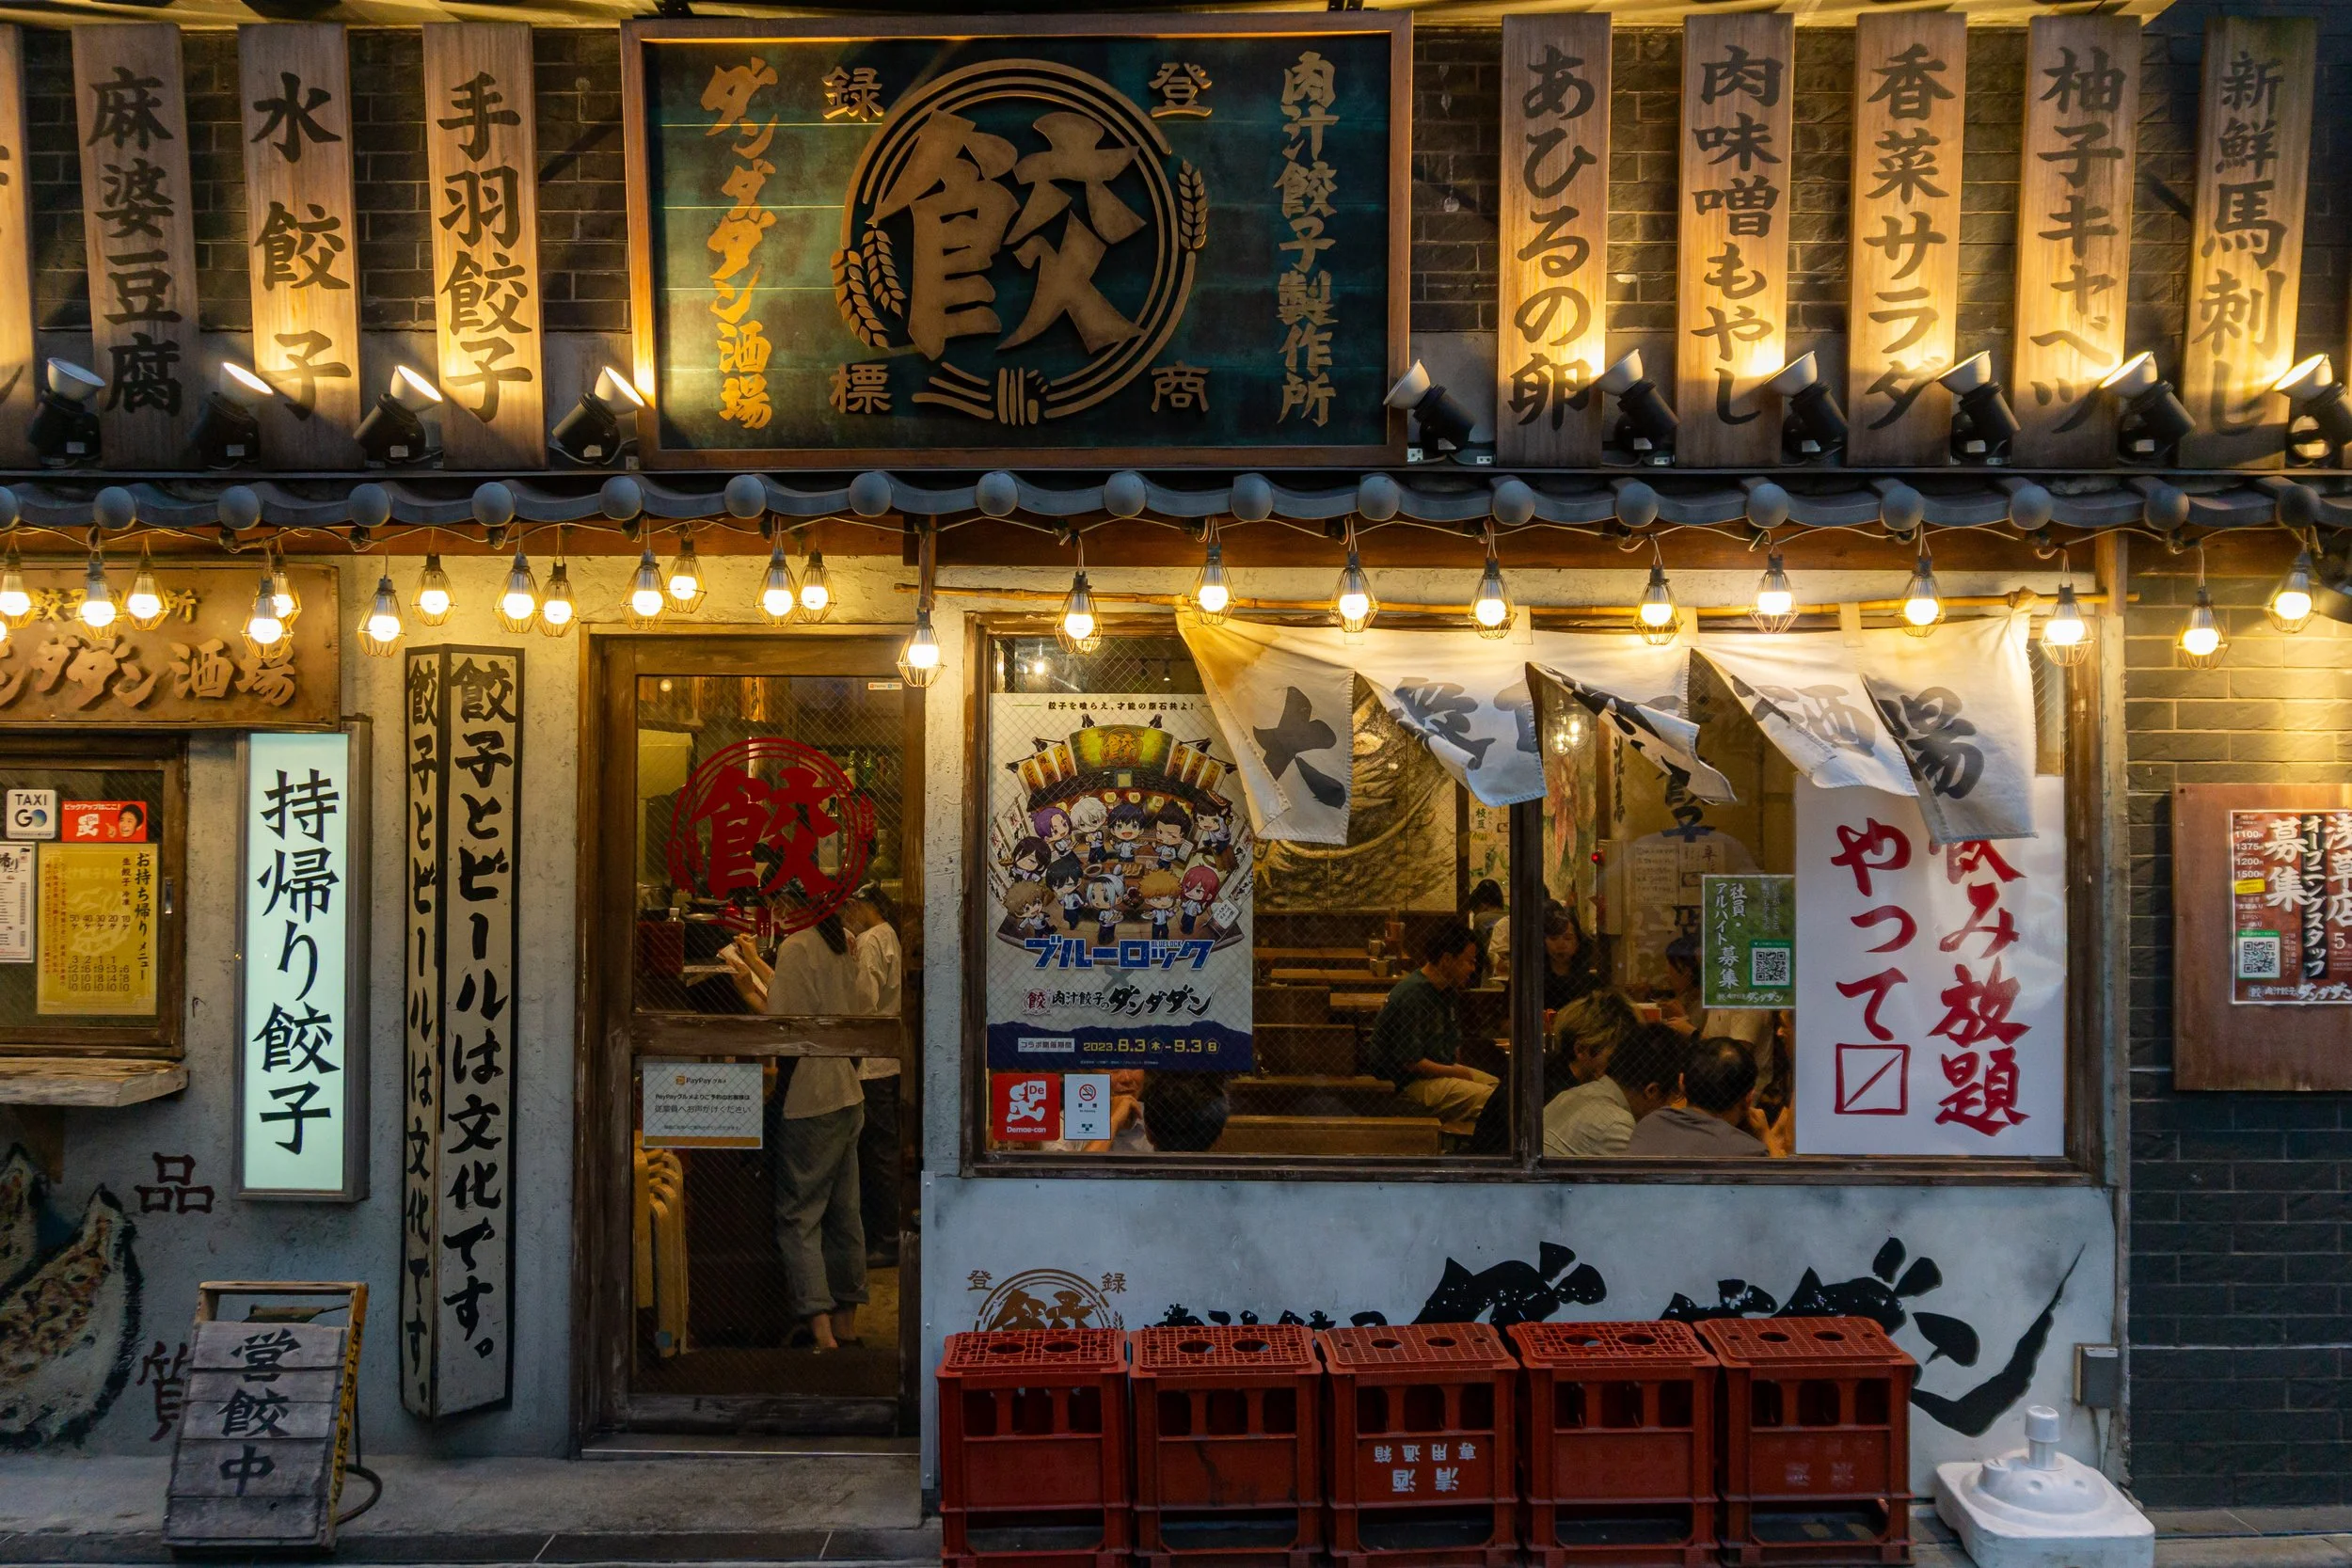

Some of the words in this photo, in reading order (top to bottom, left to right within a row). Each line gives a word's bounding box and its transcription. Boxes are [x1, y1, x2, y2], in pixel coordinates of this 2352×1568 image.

[86, 67, 182, 417] 麻婆豆腐
[250, 72, 352, 420] 水餃子
[437, 71, 532, 423] 手羽餃子
[700, 56, 779, 430] ダンダダン酒場
[1274, 50, 1340, 428] 肉汁餃子製作所
[1509, 44, 1597, 430] あひるの卵
[1691, 44, 1783, 426] 肉味噌もやし
[1863, 41, 1957, 432] 香菜サラダ
[2030, 45, 2128, 434] 柚子キャベツ
[2192, 50, 2290, 436] 新鮮馬刺し
[15, 794, 47, 806] TAXI
[252, 768, 341, 1155] 持帰り餃子
[1025, 935, 1215, 970] ブルーロック
[2265, 816, 2308, 912] 募集
[443, 657, 516, 1359] 餃子とビールは文化です。
[1029, 1085, 1045, 1095] De
